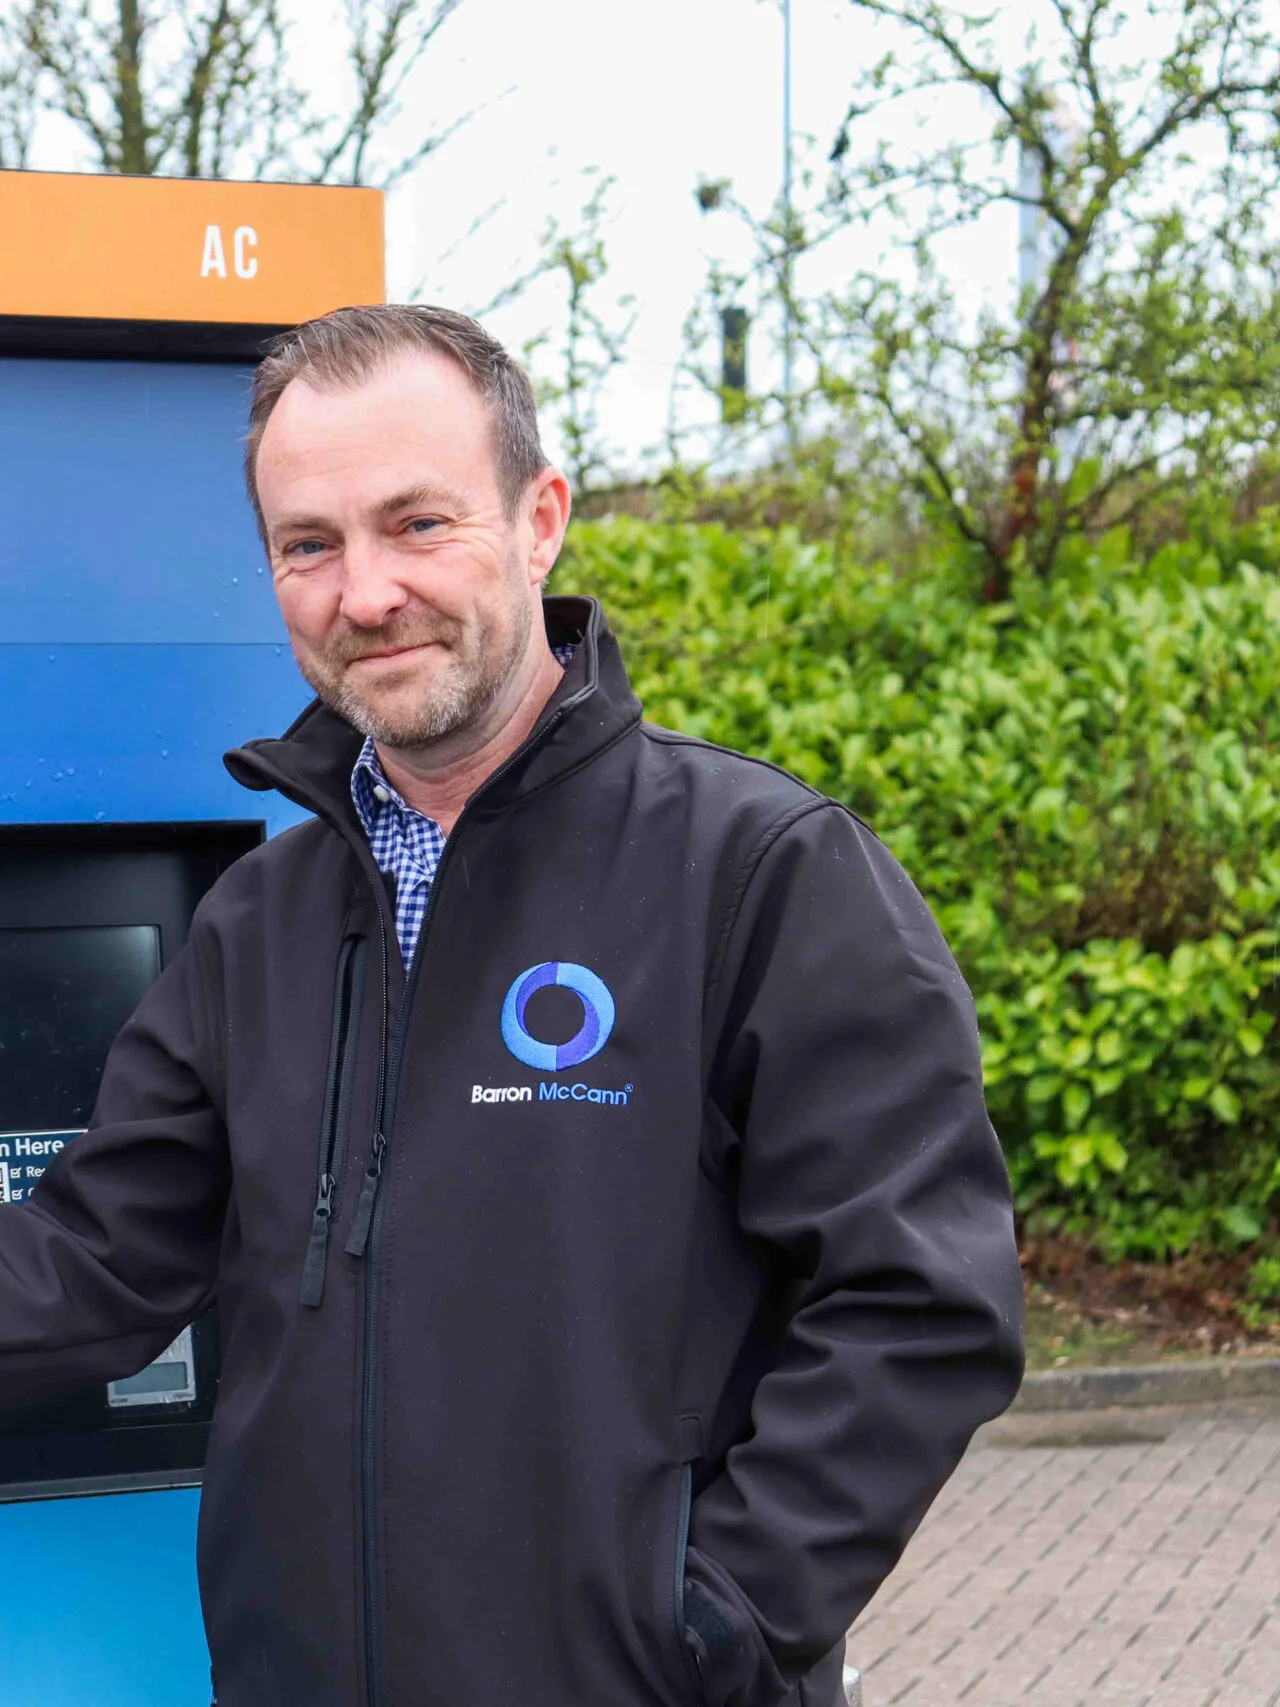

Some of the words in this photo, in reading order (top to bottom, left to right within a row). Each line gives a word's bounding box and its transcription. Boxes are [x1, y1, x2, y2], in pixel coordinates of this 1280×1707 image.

[200, 224, 259, 280] AC
[471, 1084, 533, 1104] Barron
[15, 1137, 65, 1157] Here
